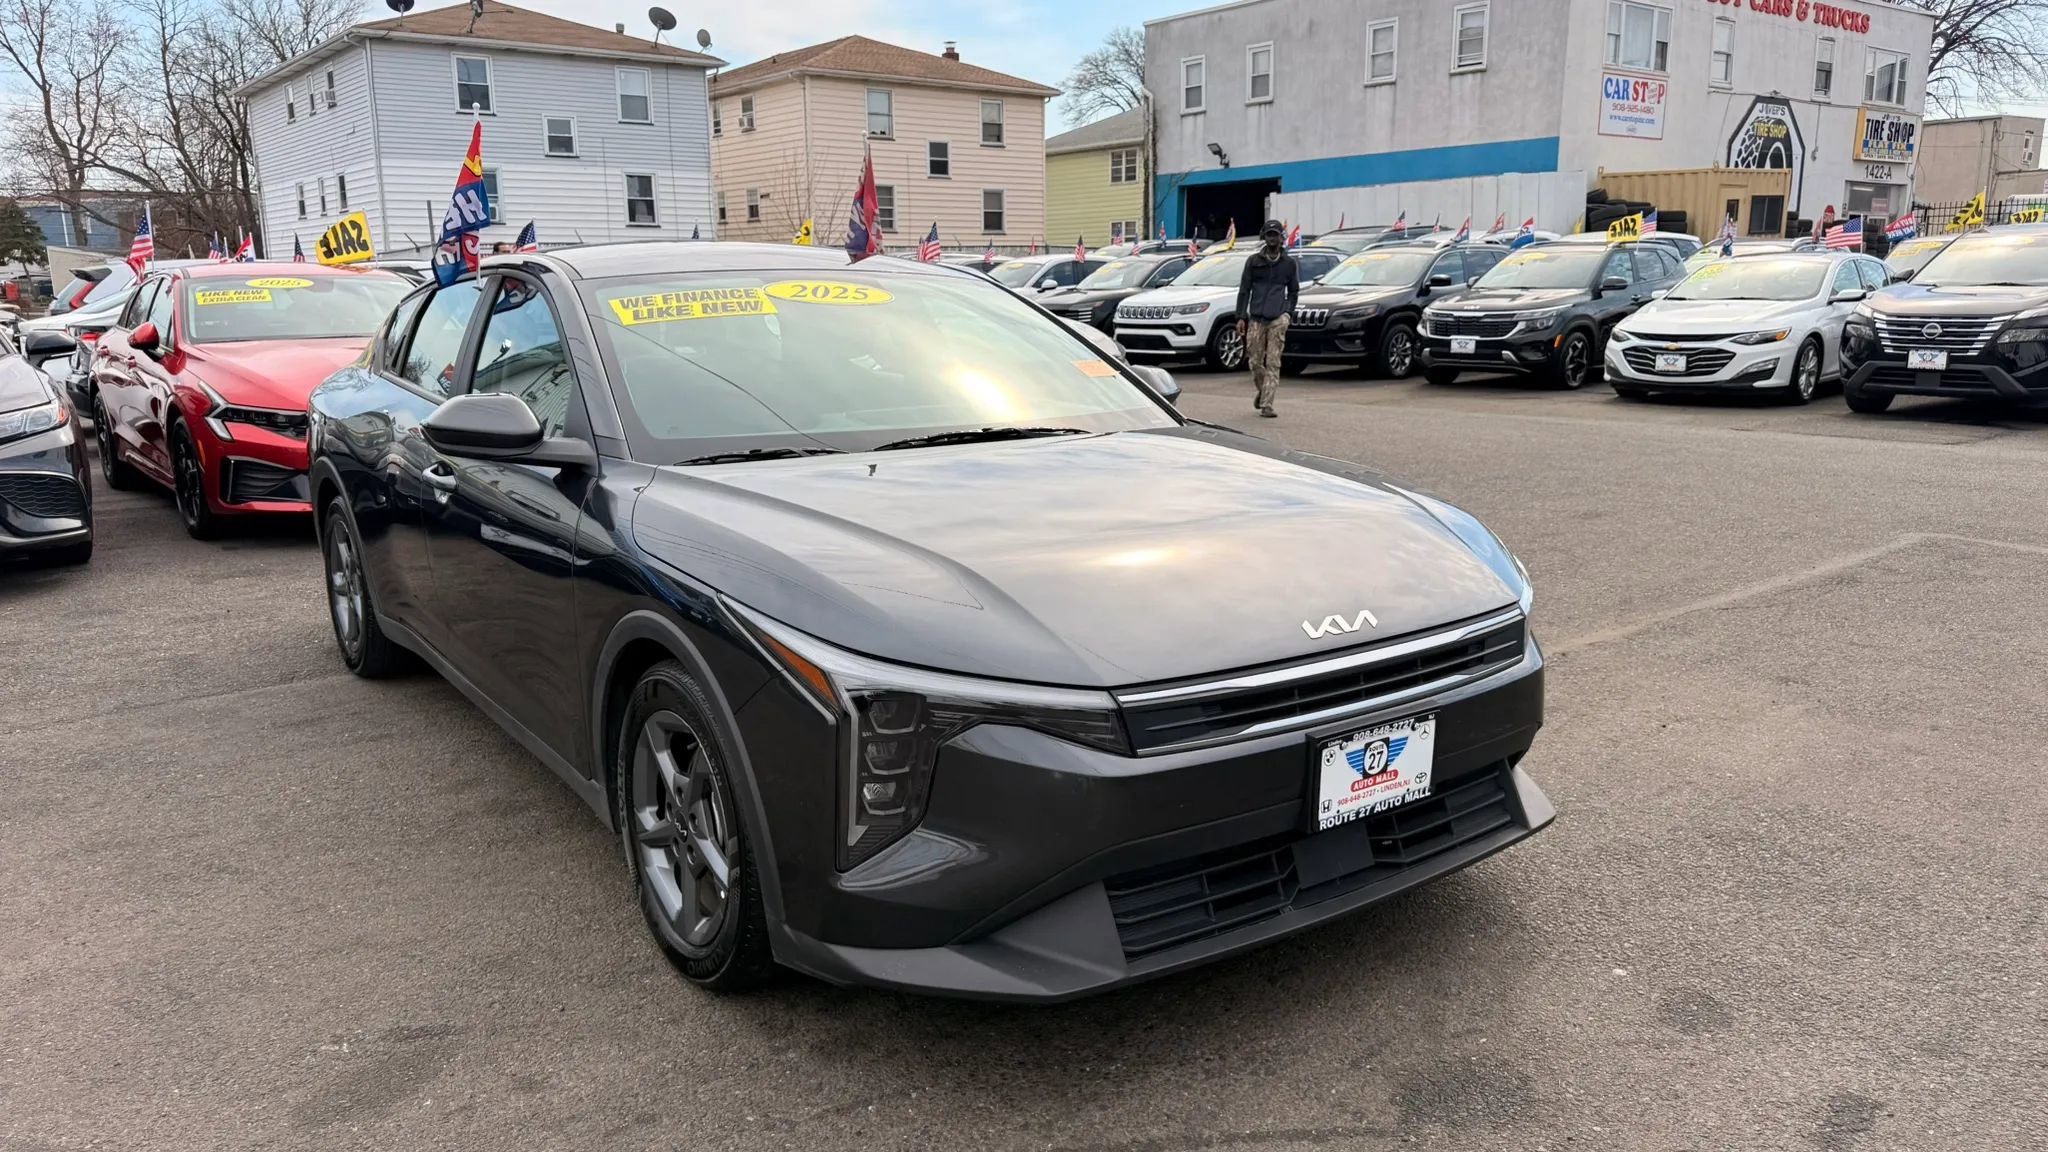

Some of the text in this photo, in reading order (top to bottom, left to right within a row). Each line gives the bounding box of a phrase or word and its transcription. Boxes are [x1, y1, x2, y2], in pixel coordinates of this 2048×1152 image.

[1796, 0, 1810, 21] &
[1813, 2, 1871, 34] TRUCKS
[1604, 77, 1630, 101] CAR
[1754, 122, 1787, 138] TIRE SHOP
[1866, 118, 1915, 143] TIRE SHOP
[618, 289, 759, 310] WE FINANCE
[790, 284, 869, 300] 2025
[632, 300, 763, 322] LIKE NEW
[1302, 609, 1378, 639] KIA
[1353, 719, 1415, 741] 908-648-2727
[1369, 744, 1384, 752] ROUTE
[1368, 751, 1384, 771] 27
[1353, 771, 1396, 790] AUTO MALL
[1337, 789, 1376, 806] 908-648-2727
[1320, 786, 1431, 831] ROUTE 27 AUTO MALL
